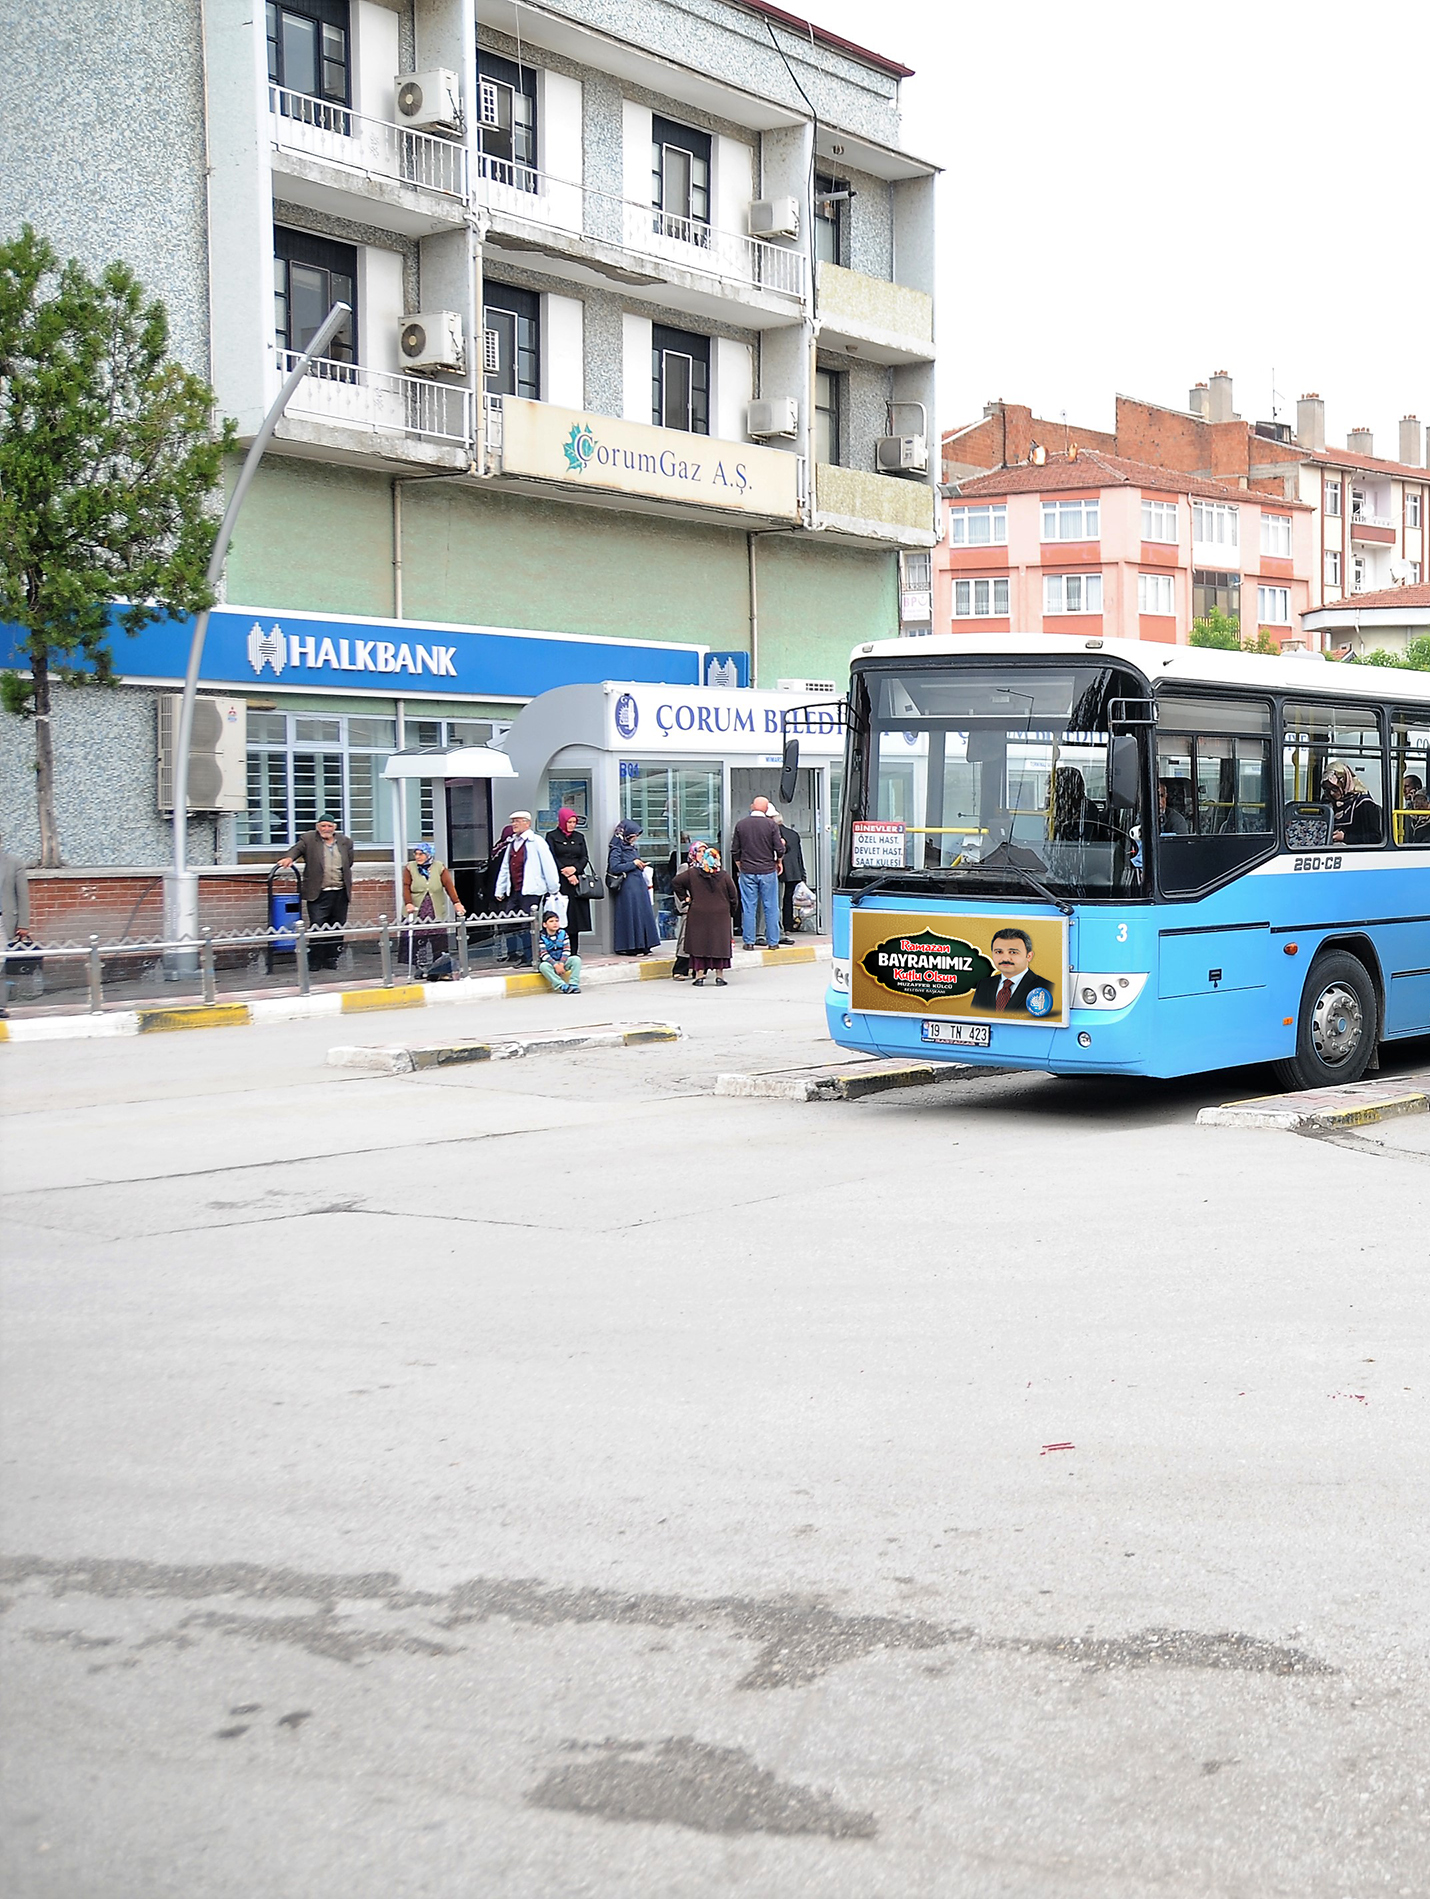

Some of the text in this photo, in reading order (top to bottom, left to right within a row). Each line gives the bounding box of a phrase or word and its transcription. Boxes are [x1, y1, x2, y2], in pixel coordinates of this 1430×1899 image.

[576, 433, 753, 495] ÇorumGaz A.Ş.
[289, 634, 458, 677] HALKBANK
[656, 704, 756, 737] ÇORUM
[619, 762, 640, 778] B01
[854, 824, 898, 833] BİNEVLER
[858, 834, 899, 844] ÖZEL HAST.
[854, 846, 903, 856] DEVLET HAST.
[856, 857, 874, 866] SAAT
[1116, 923, 1128, 942] 3
[900, 940, 950, 953] Ramazan
[878, 952, 973, 972] BAYRAMIMIZ
[893, 968, 957, 983] Kutlu Olsun
[930, 1024, 987, 1041] 19 TN 423
